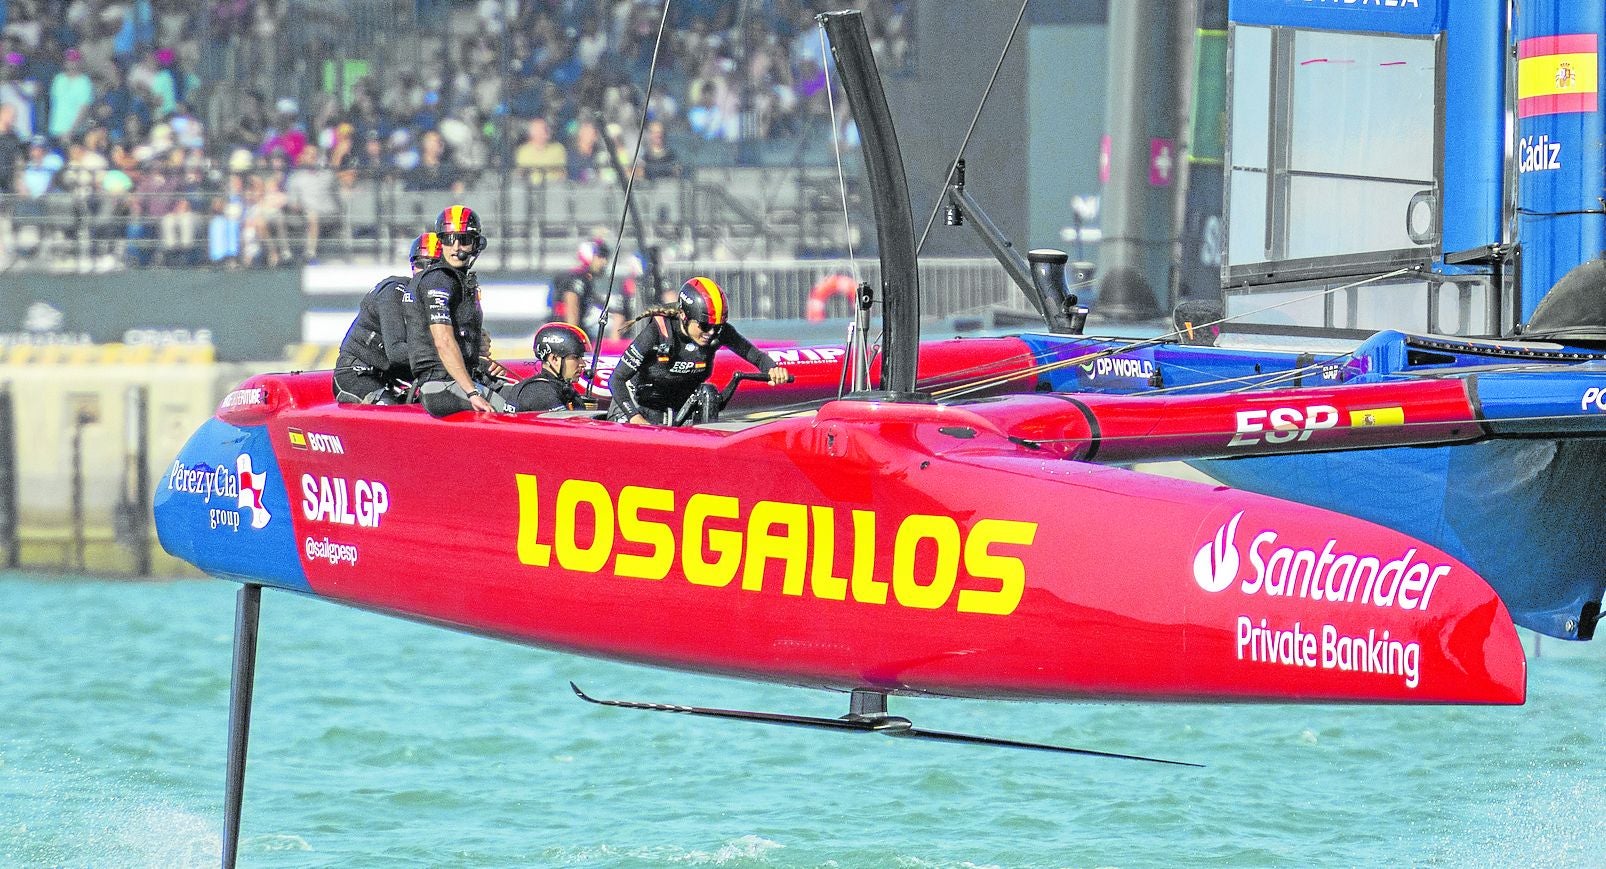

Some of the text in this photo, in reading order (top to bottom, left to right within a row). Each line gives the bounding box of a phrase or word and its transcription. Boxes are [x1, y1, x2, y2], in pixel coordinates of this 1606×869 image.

[1519, 134, 1560, 173] Cádiz
[672, 361, 695, 370] ESP
[1112, 358, 1154, 378] WORLD
[1227, 404, 1339, 447] ESP
[307, 431, 345, 455] BOTIN
[209, 508, 240, 532] group
[305, 536, 358, 566] @sailgpesp
[1241, 530, 1452, 611] Santander
[1237, 615, 1421, 688] Private Banking
